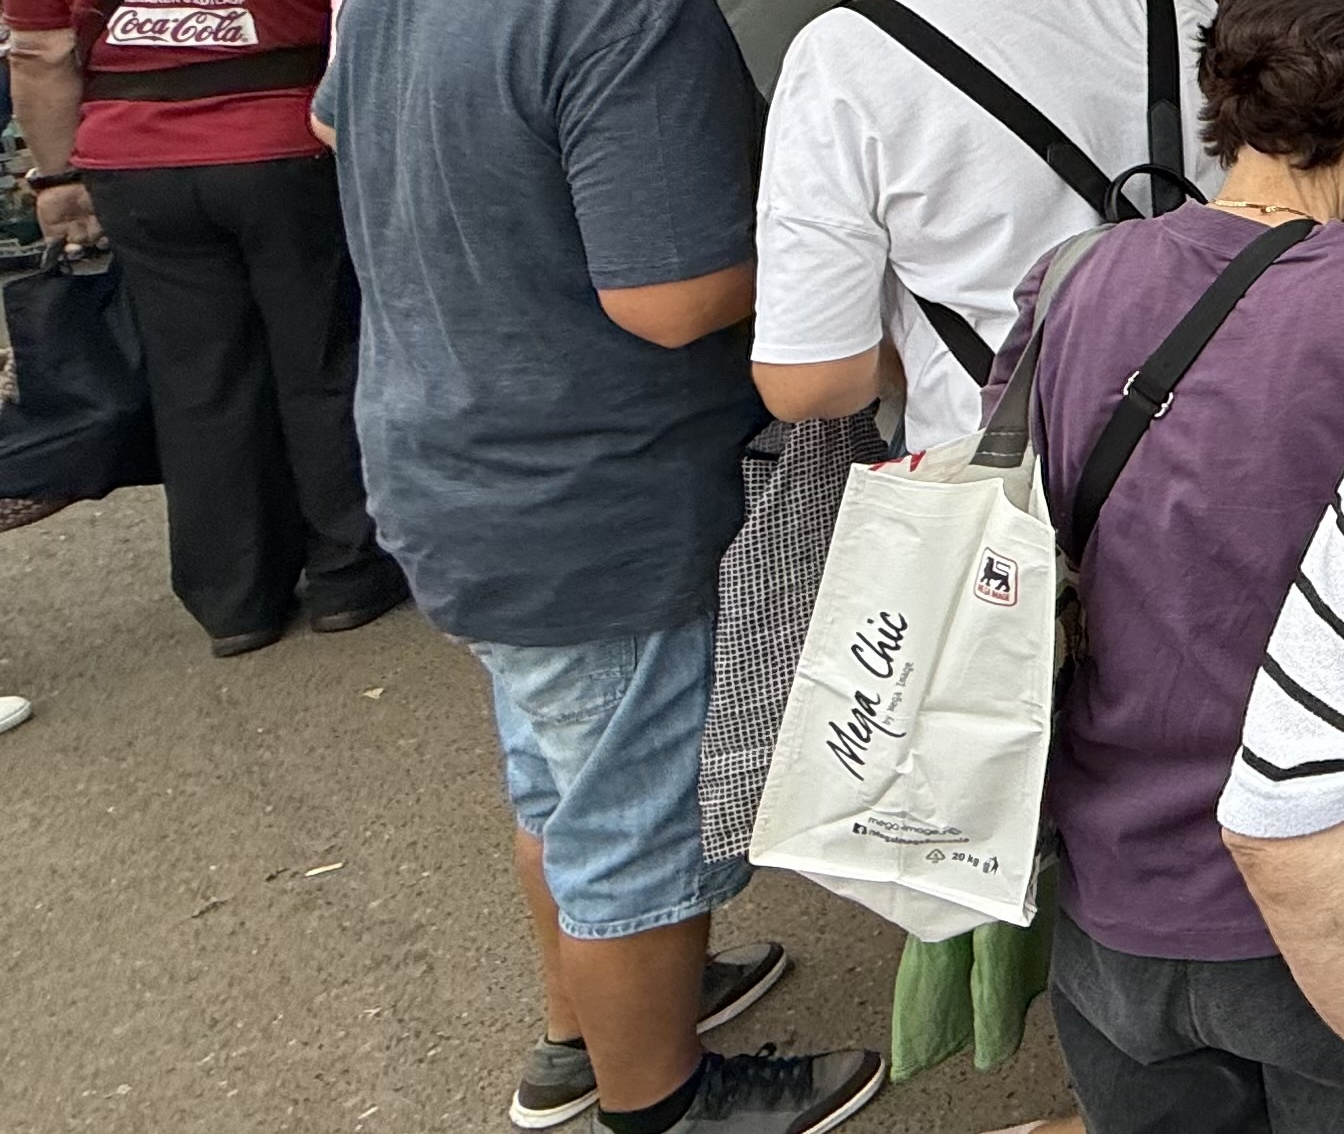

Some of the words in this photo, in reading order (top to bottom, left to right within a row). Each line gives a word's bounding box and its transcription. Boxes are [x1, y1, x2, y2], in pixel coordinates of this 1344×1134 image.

[110, 9, 248, 43] Coca-Cola
[850, 611, 908, 679] Chic
[826, 690, 907, 782] Mega
[951, 851, 966, 862] 20
[966, 854, 980, 868] kg
